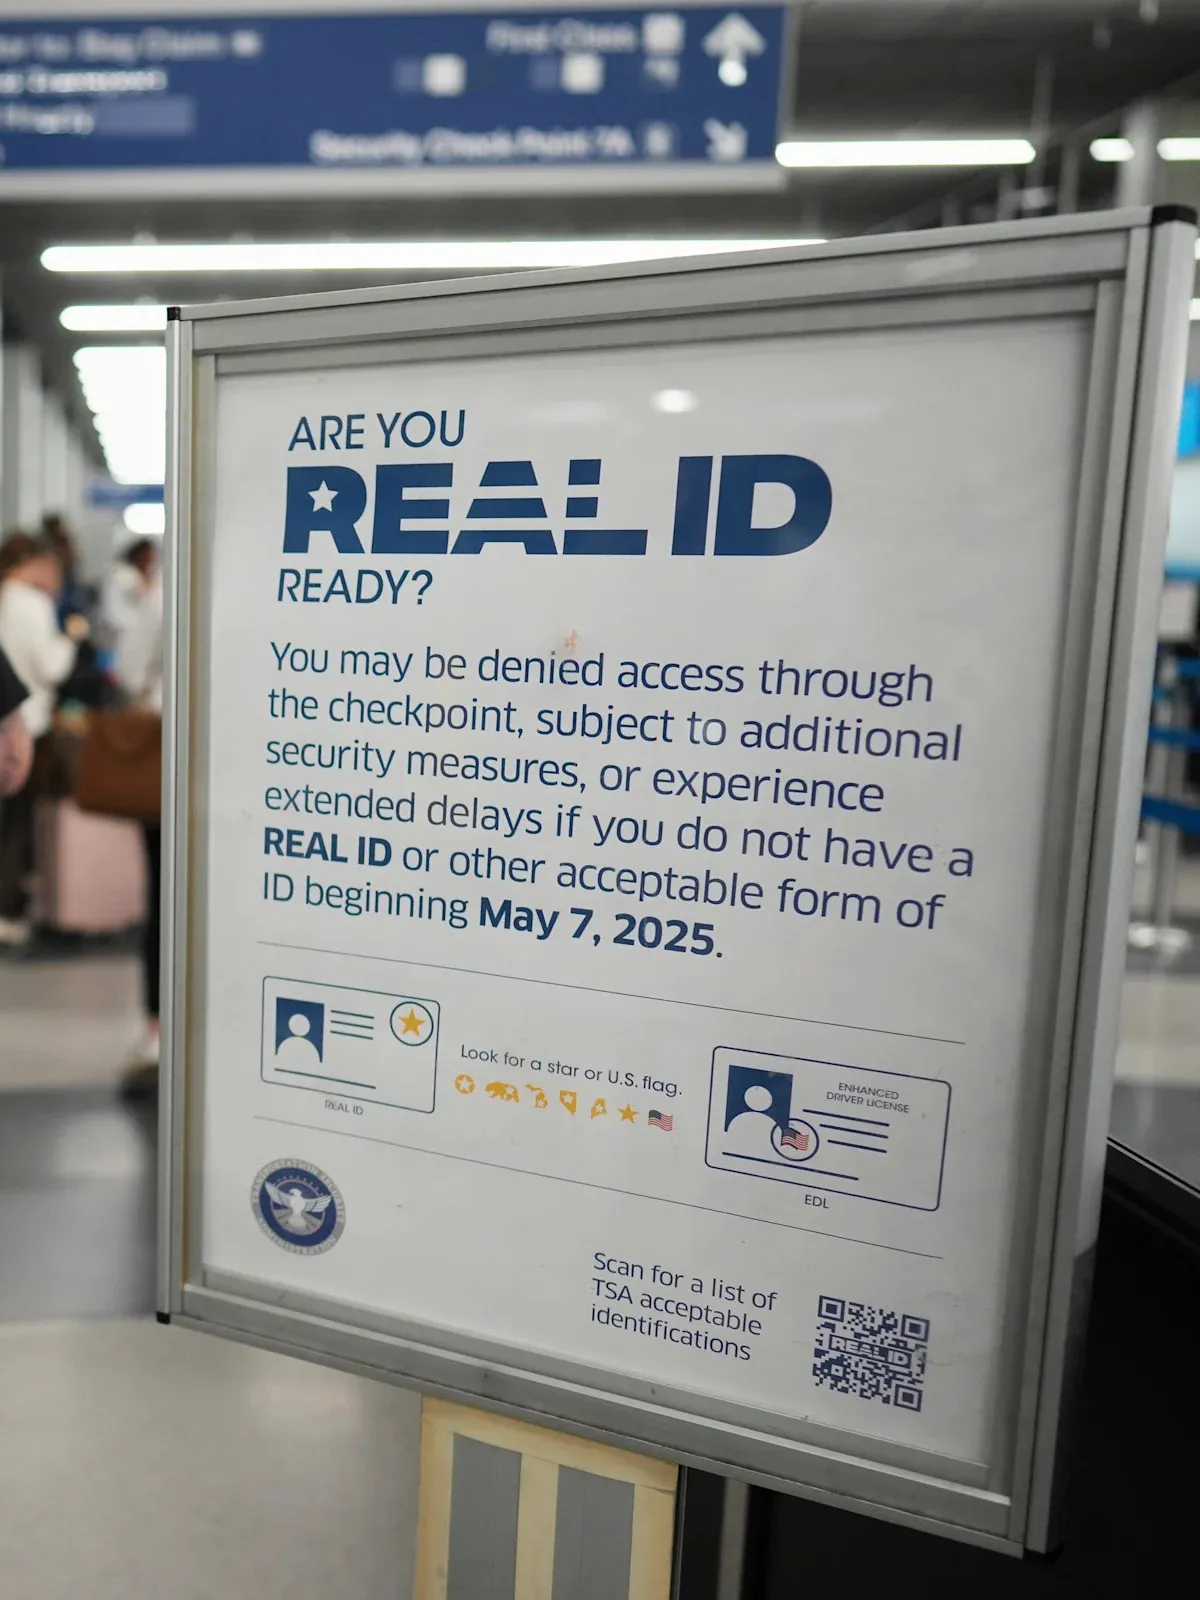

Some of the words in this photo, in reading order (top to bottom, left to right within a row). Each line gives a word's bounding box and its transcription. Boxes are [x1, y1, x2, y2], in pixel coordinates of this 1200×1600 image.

[288, 414, 366, 452] ARE
[376, 409, 467, 449] YOU
[283, 459, 649, 556] REAL
[671, 454, 833, 557] ID
[277, 568, 434, 606] READY?
[270, 641, 329, 674] You
[340, 650, 414, 684] may
[425, 646, 467, 681] be
[478, 649, 605, 687] denied
[618, 661, 745, 694] access
[758, 659, 934, 708] through
[268, 688, 320, 721] the
[329, 691, 524, 740] checkpoint,
[537, 704, 676, 746] subject
[687, 711, 727, 747] to
[740, 714, 963, 762] additional
[266, 739, 397, 779] security
[407, 751, 587, 795] measures,
[600, 764, 642, 793] or
[653, 768, 885, 813] experience
[265, 784, 416, 824] extended
[427, 794, 543, 839] delays
[556, 804, 583, 839] if
[592, 815, 665, 848] you
[677, 816, 728, 853] do
[742, 827, 812, 862] not
[824, 828, 934, 874] have
[948, 848, 974, 878] a
[264, 827, 349, 864] REAL
[358, 836, 393, 868] ID
[403, 847, 440, 873] or
[450, 847, 547, 885] other
[557, 862, 764, 910] acceptable
[777, 878, 882, 924] form
[896, 894, 947, 930] of
[264, 872, 295, 903] ID
[306, 875, 470, 930] beginning
[479, 896, 561, 941] May
[570, 907, 602, 948] 7,
[613, 913, 723, 959] 2025.
[461, 1045, 499, 1064] Look
[504, 1052, 526, 1069] for
[531, 1060, 542, 1072] a
[548, 1061, 580, 1078] star
[584, 1069, 603, 1081] or
[608, 1070, 639, 1089] U.S.
[642, 1076, 683, 1098] flag.
[838, 1082, 899, 1100] ENHANCED
[324, 1100, 350, 1113] REAL
[352, 1104, 364, 1116] ID
[826, 1092, 864, 1106] DRIVER
[866, 1099, 910, 1114] LICENSE
[804, 1193, 830, 1210] EDL
[592, 1278, 634, 1305] TSA
[640, 1292, 763, 1336] acceptable
[594, 1252, 644, 1281] Scan
[651, 1265, 685, 1289] for
[691, 1278, 704, 1295] a
[712, 1278, 746, 1305] list
[752, 1292, 779, 1311] of
[591, 1304, 751, 1361] identifications
[831, 1336, 885, 1361] REAL
[888, 1350, 909, 1366] ID
